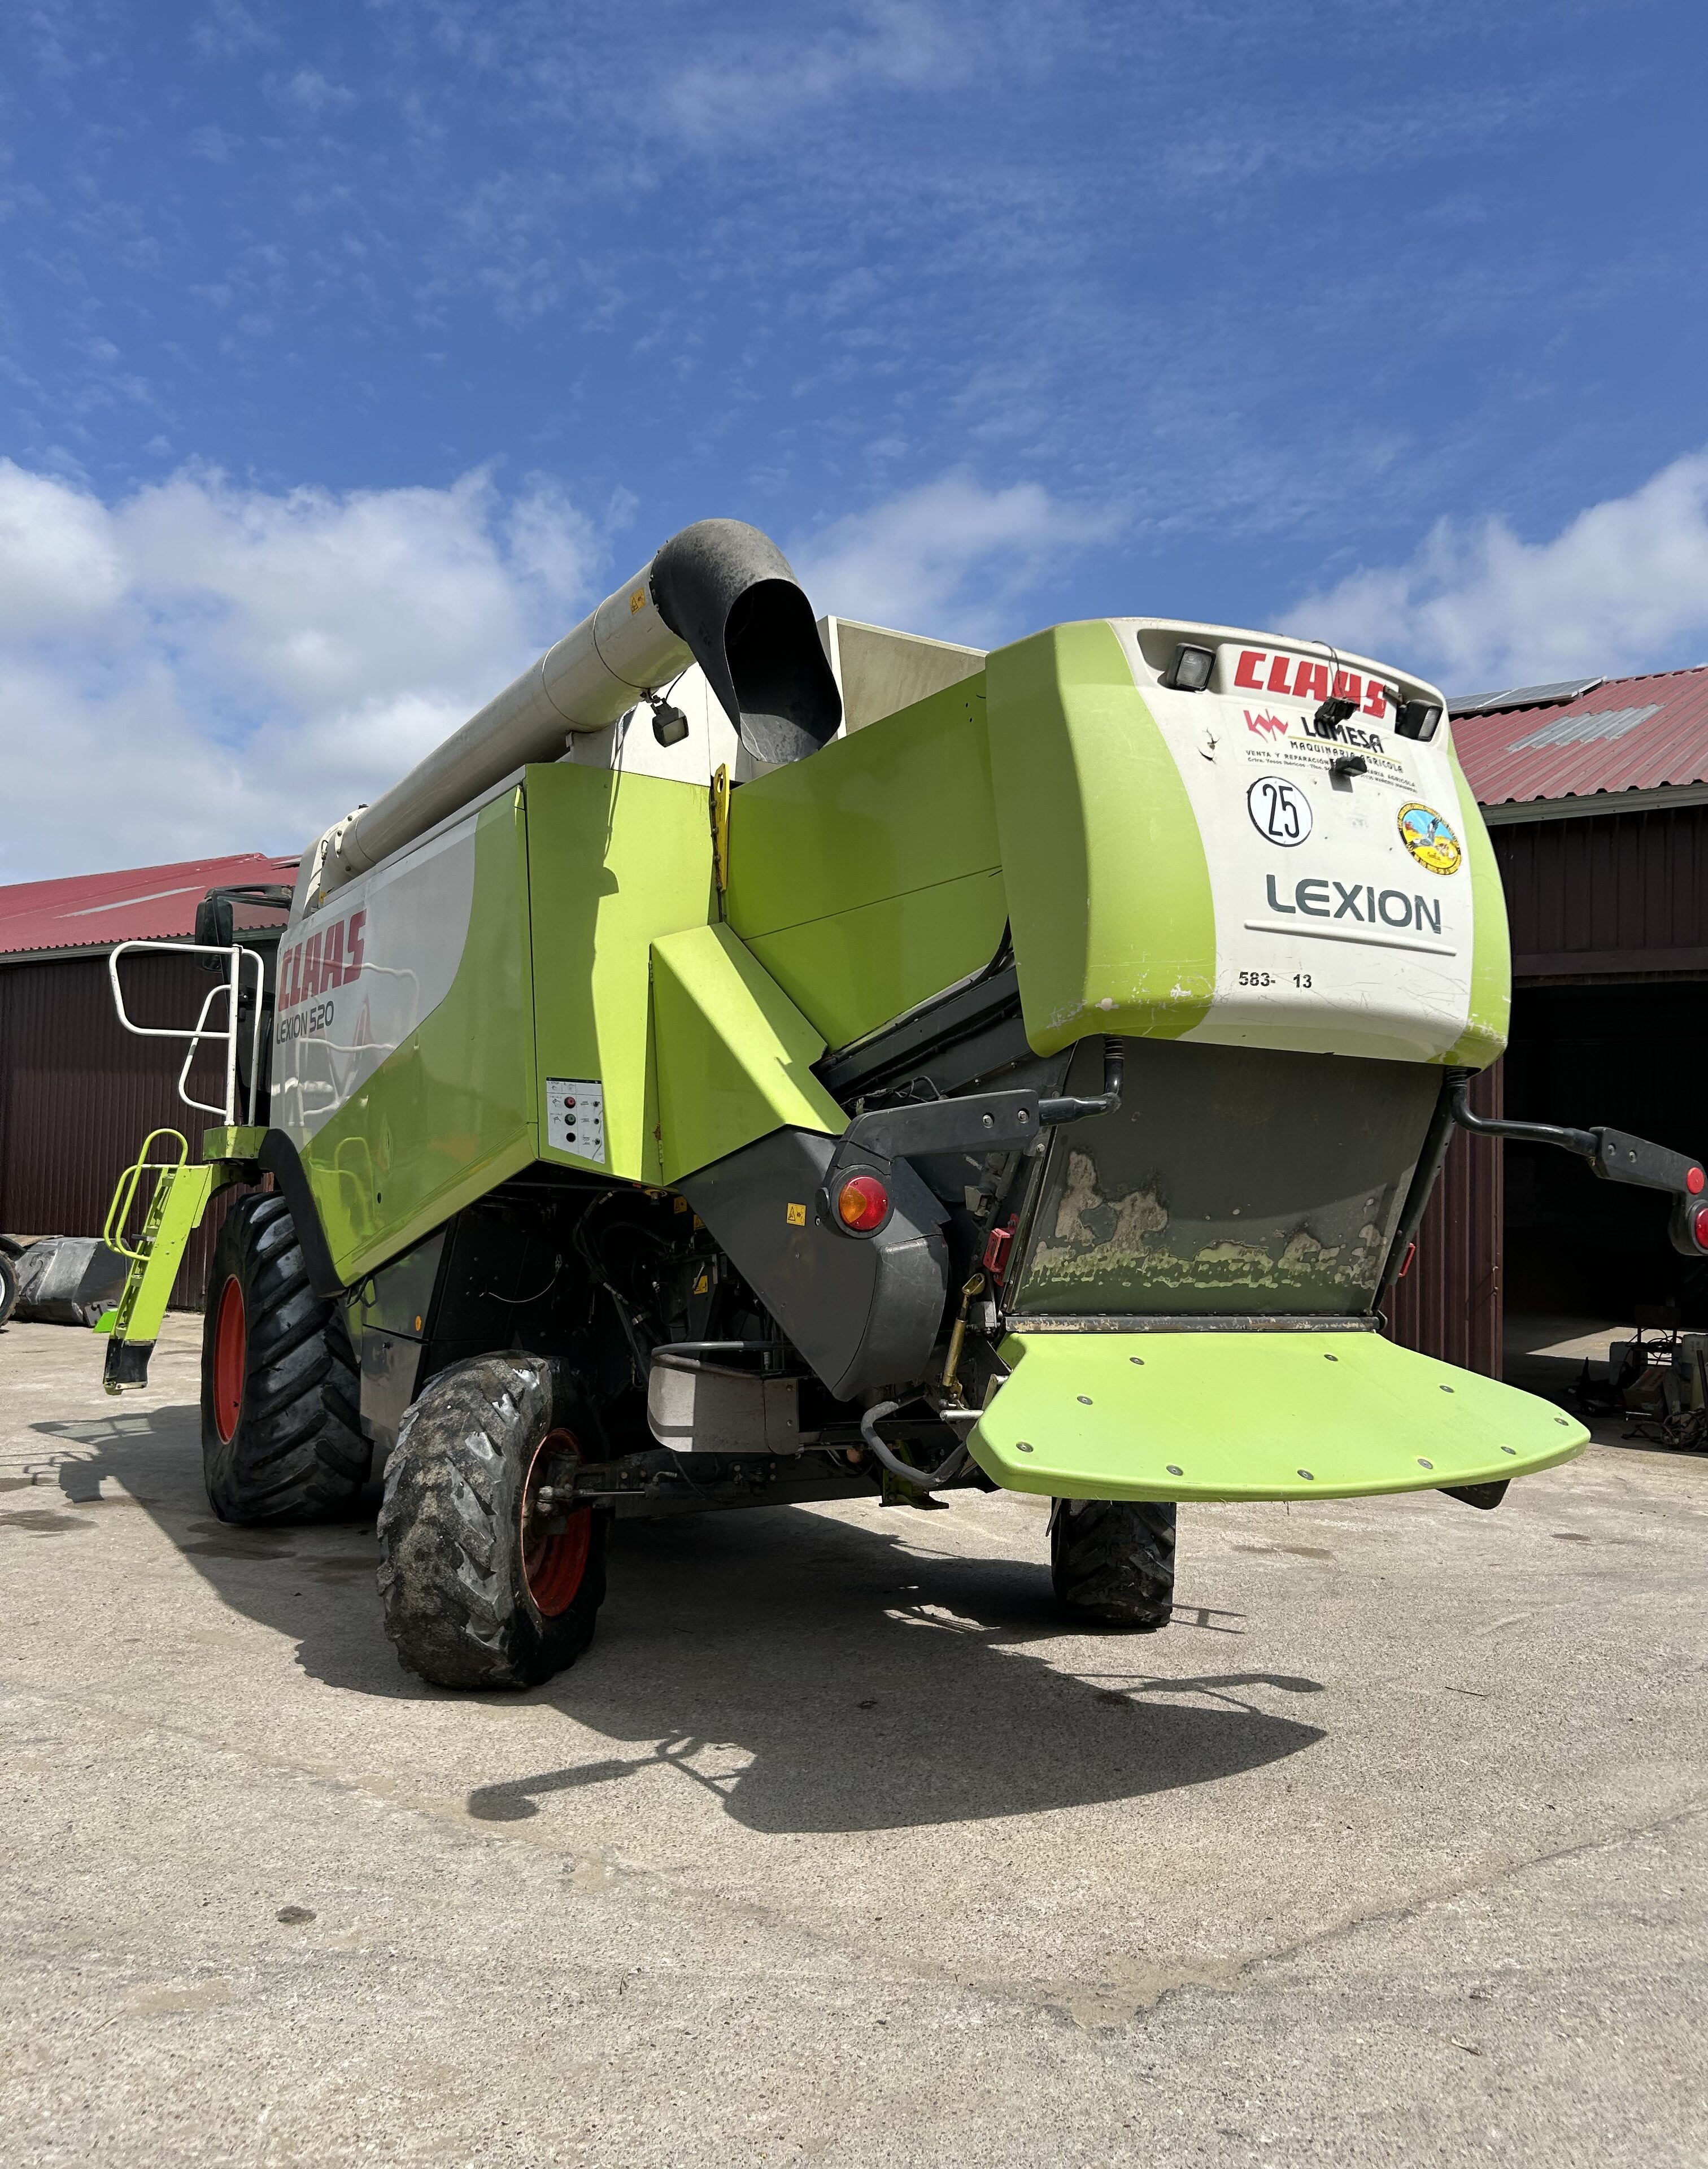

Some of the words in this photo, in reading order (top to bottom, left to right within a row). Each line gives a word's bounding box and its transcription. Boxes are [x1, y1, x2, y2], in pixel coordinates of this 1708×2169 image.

[1234, 651, 1387, 719] CLAAS
[1262, 783, 1299, 838] 25
[1266, 874, 1441, 934] LEXION
[278, 908, 367, 1012] CLAAS
[1293, 974, 1312, 988] 13
[276, 1011, 308, 1044] LEXION
[310, 1000, 334, 1033] 520
